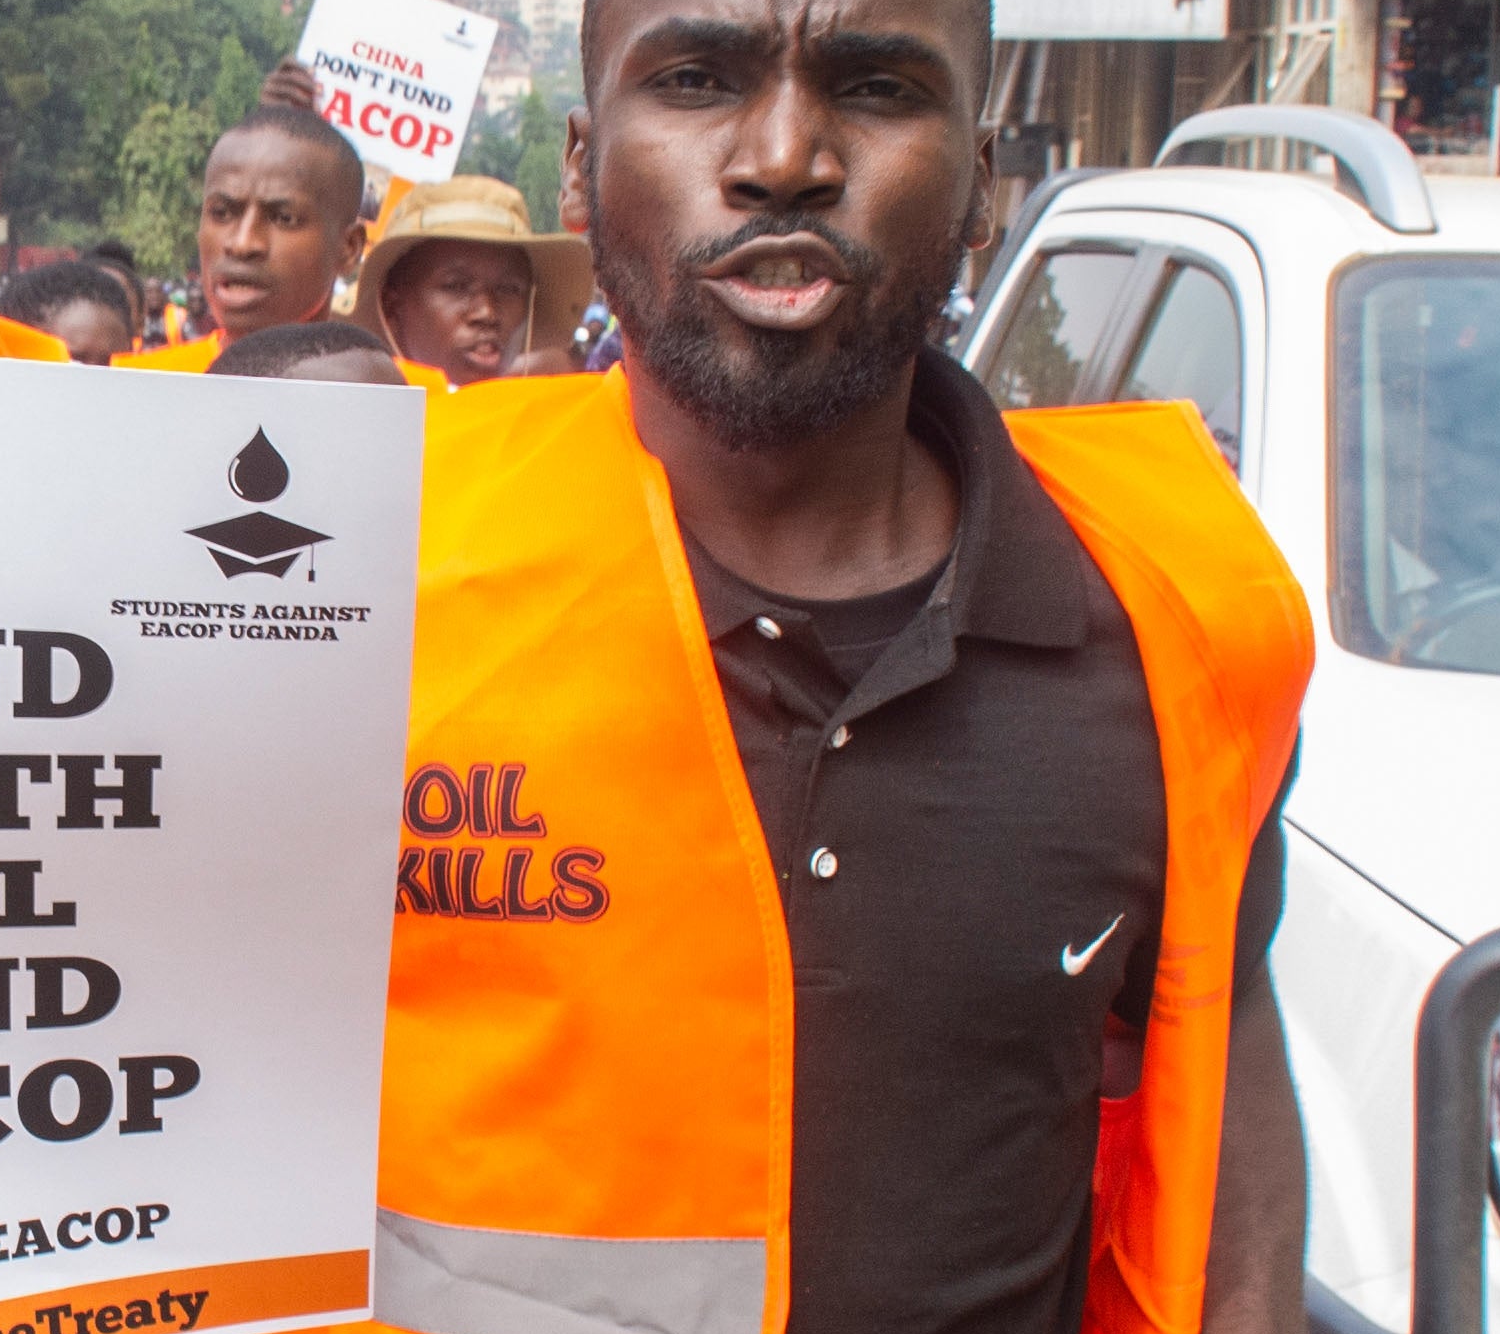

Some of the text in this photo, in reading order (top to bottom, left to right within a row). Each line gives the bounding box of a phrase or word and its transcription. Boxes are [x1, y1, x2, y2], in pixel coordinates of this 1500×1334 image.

[313, 49, 453, 115] DON'T FUND
[352, 40, 425, 79] CHINA
[110, 599, 371, 622] STUDENTS AGAINST
[141, 621, 339, 641] EACOP UGANDA
[402, 762, 547, 838] OIL
[395, 846, 610, 923] KILLS
